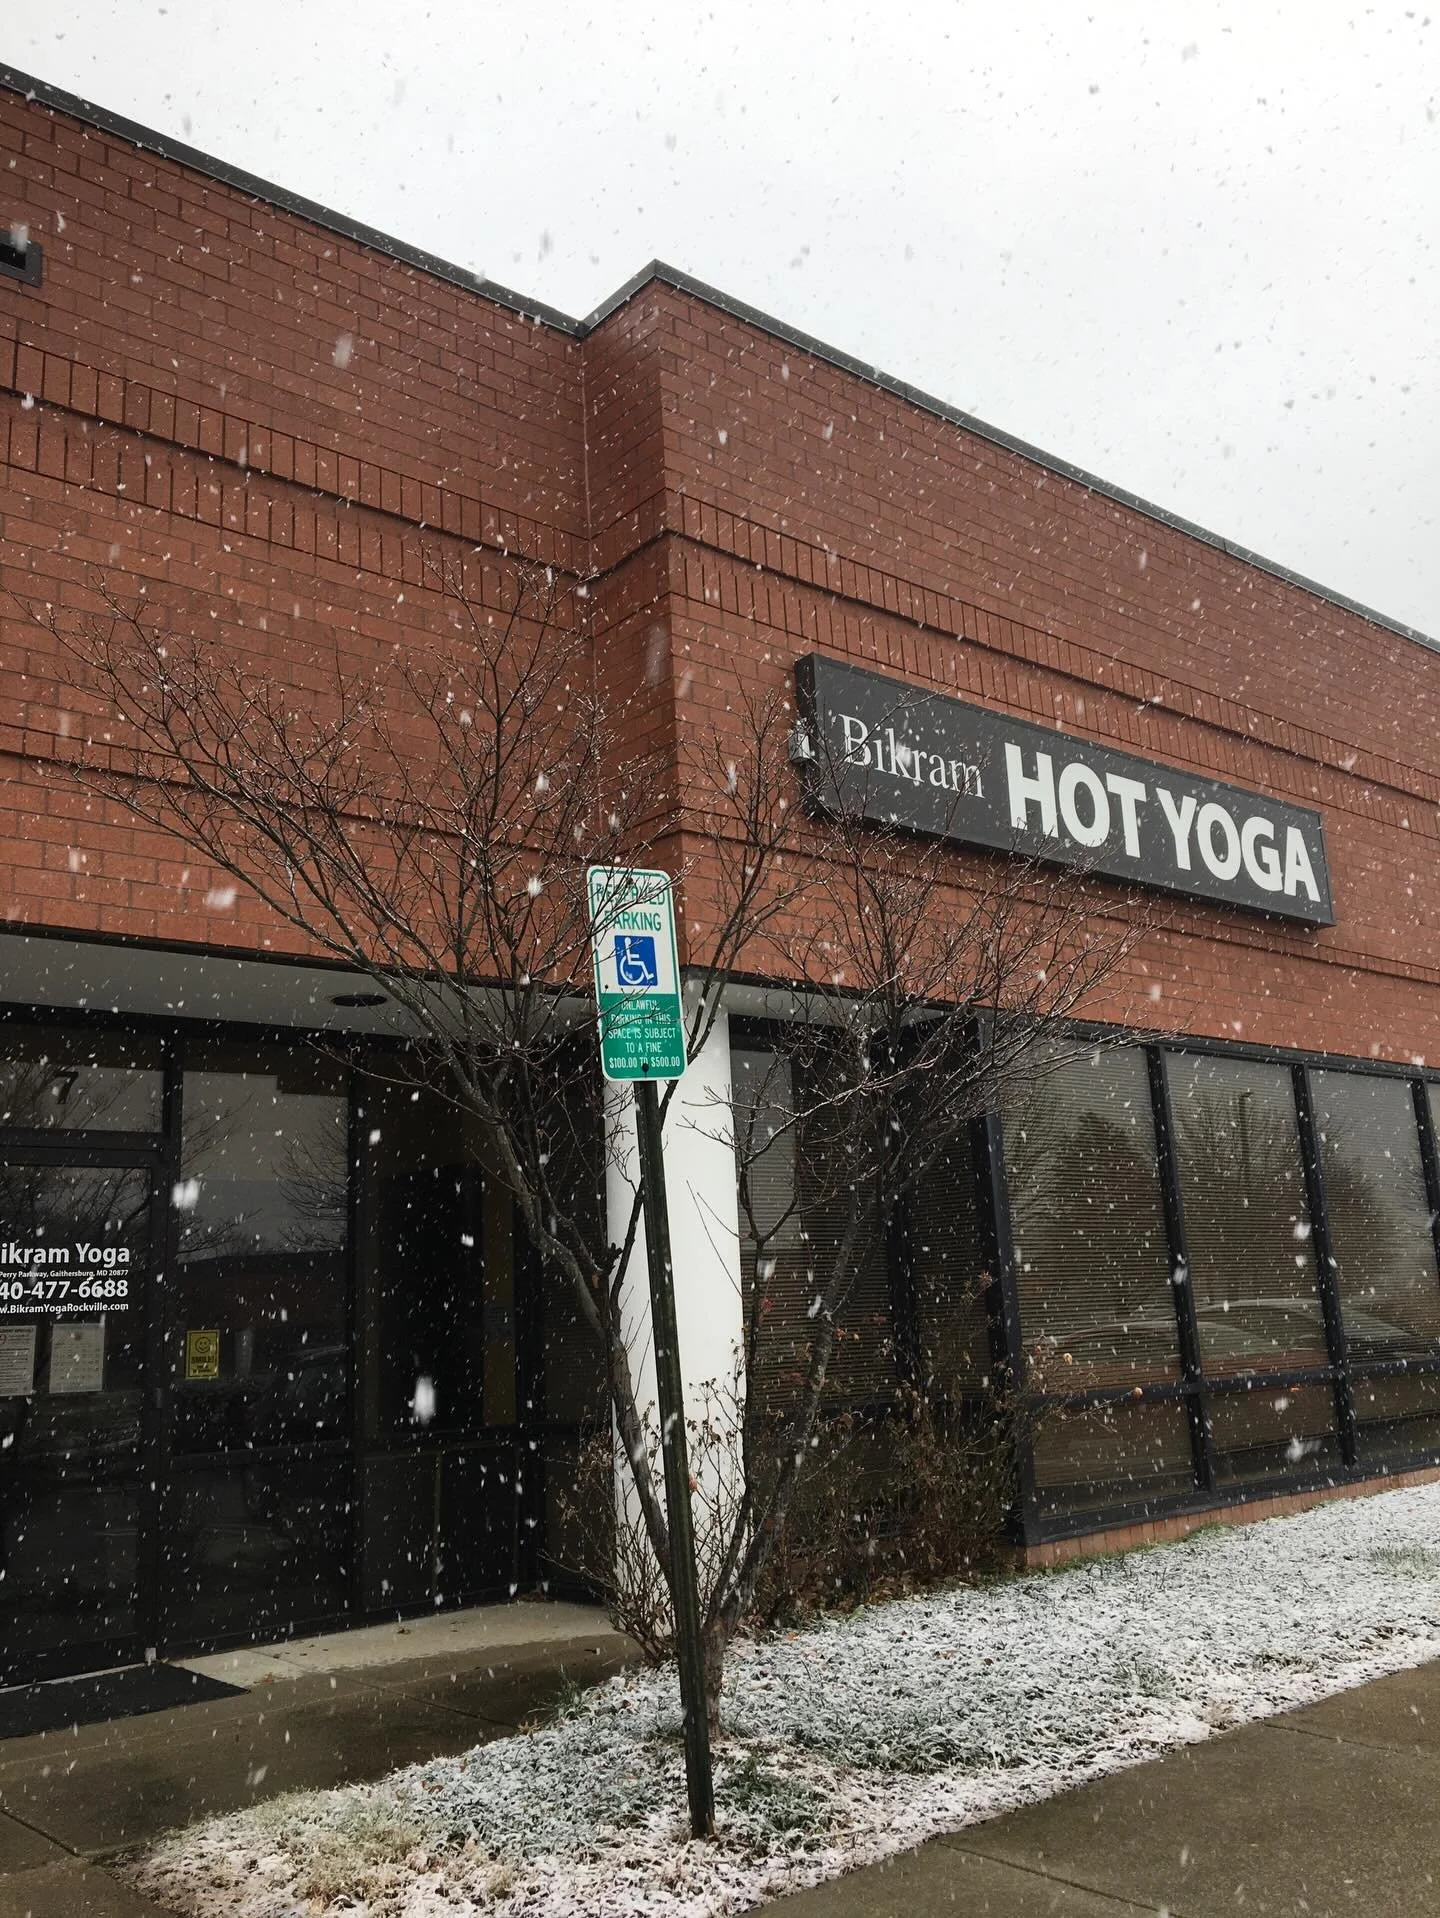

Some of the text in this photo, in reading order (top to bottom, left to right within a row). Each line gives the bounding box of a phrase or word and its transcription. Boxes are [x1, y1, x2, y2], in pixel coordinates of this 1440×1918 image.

[838, 713, 1321, 903] Bikram HOT YOGA
[604, 911, 662, 932] PARKING
[621, 1001, 661, 1011] UNLAWFUL
[609, 1027, 676, 1039] SPACE IS SUBJECT
[625, 1042, 663, 1054] TO A FINE
[609, 1057, 637, 1069] $100.00
[650, 1056, 681, 1068] $500.00
[75, 1242, 130, 1268] Yoga
[96, 1269, 108, 1277] MD
[0, 1279, 128, 1300] 40-477-6688
